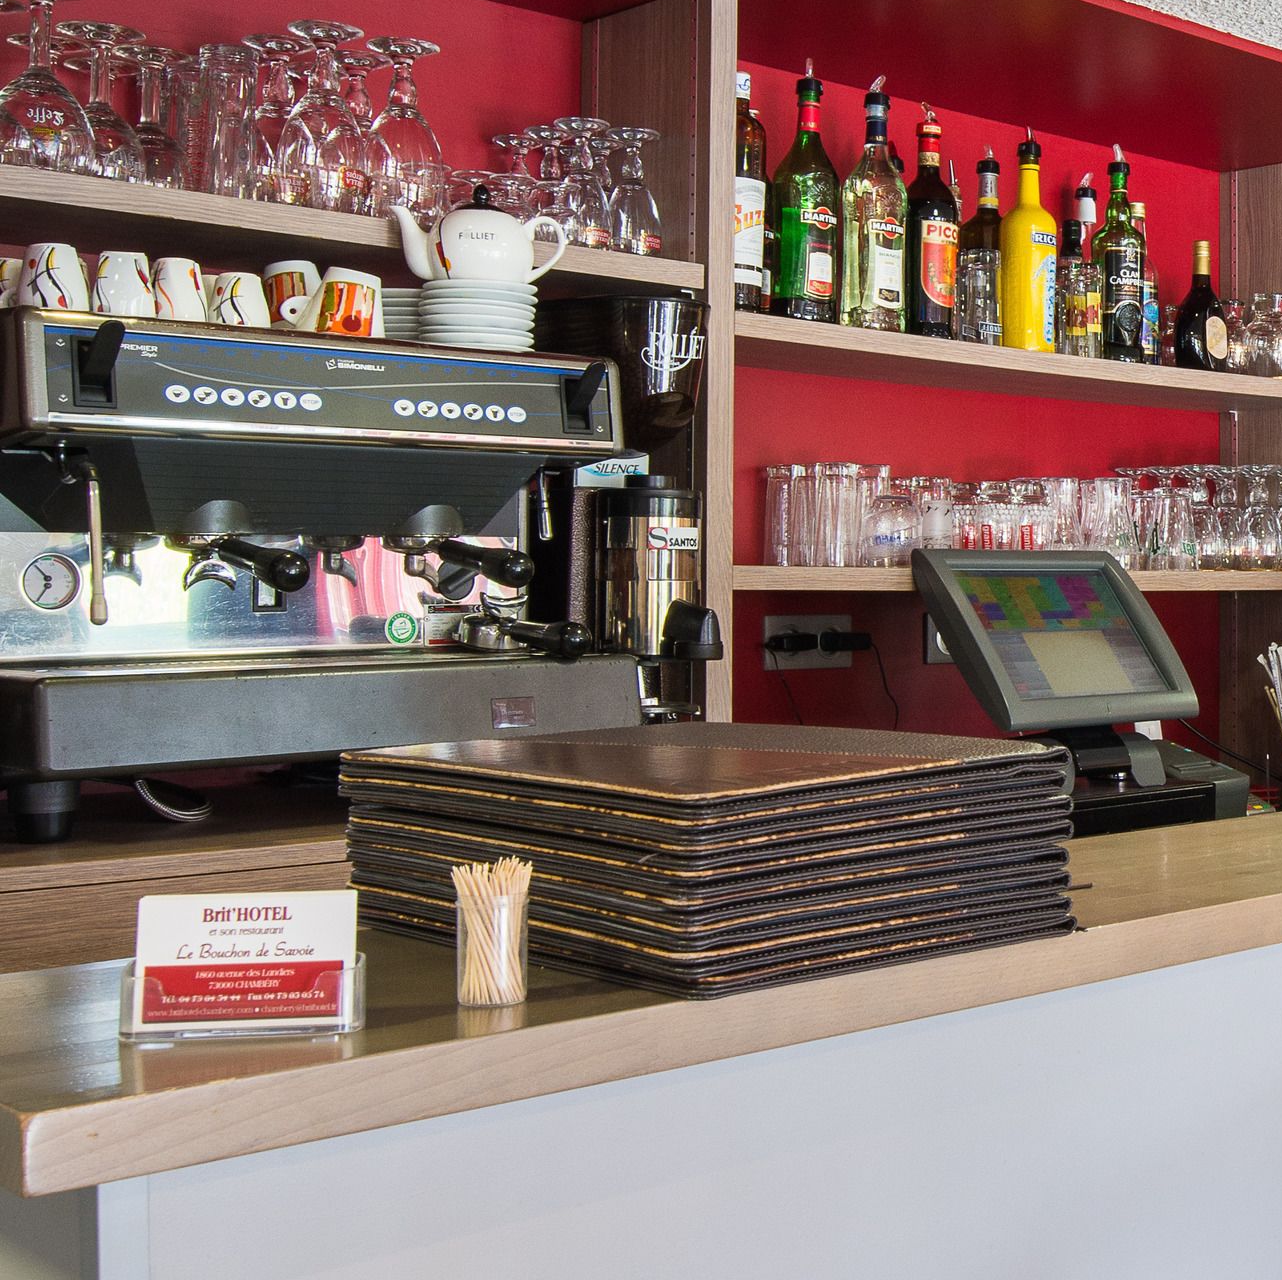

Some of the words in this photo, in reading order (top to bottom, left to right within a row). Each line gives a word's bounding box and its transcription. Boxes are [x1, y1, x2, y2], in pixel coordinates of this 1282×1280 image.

[26, 106, 64, 126] Leffe
[734, 204, 764, 234] Suz
[926, 224, 957, 240] PICO
[337, 363, 385, 372] SIMONELLI
[594, 463, 639, 475] SILENCE
[669, 537, 697, 547] SANTOS
[202, 906, 292, 923] Brit'HOTEL
[209, 928, 217, 936] et
[219, 928, 237, 936] son
[239, 926, 284, 936] restaurant
[176, 943, 193, 960] Le
[199, 942, 250, 959] Bouchon
[255, 942, 269, 958] de
[274, 941, 316, 958] Savoie
[216, 971, 245, 979] avenue
[246, 969, 261, 977] des
